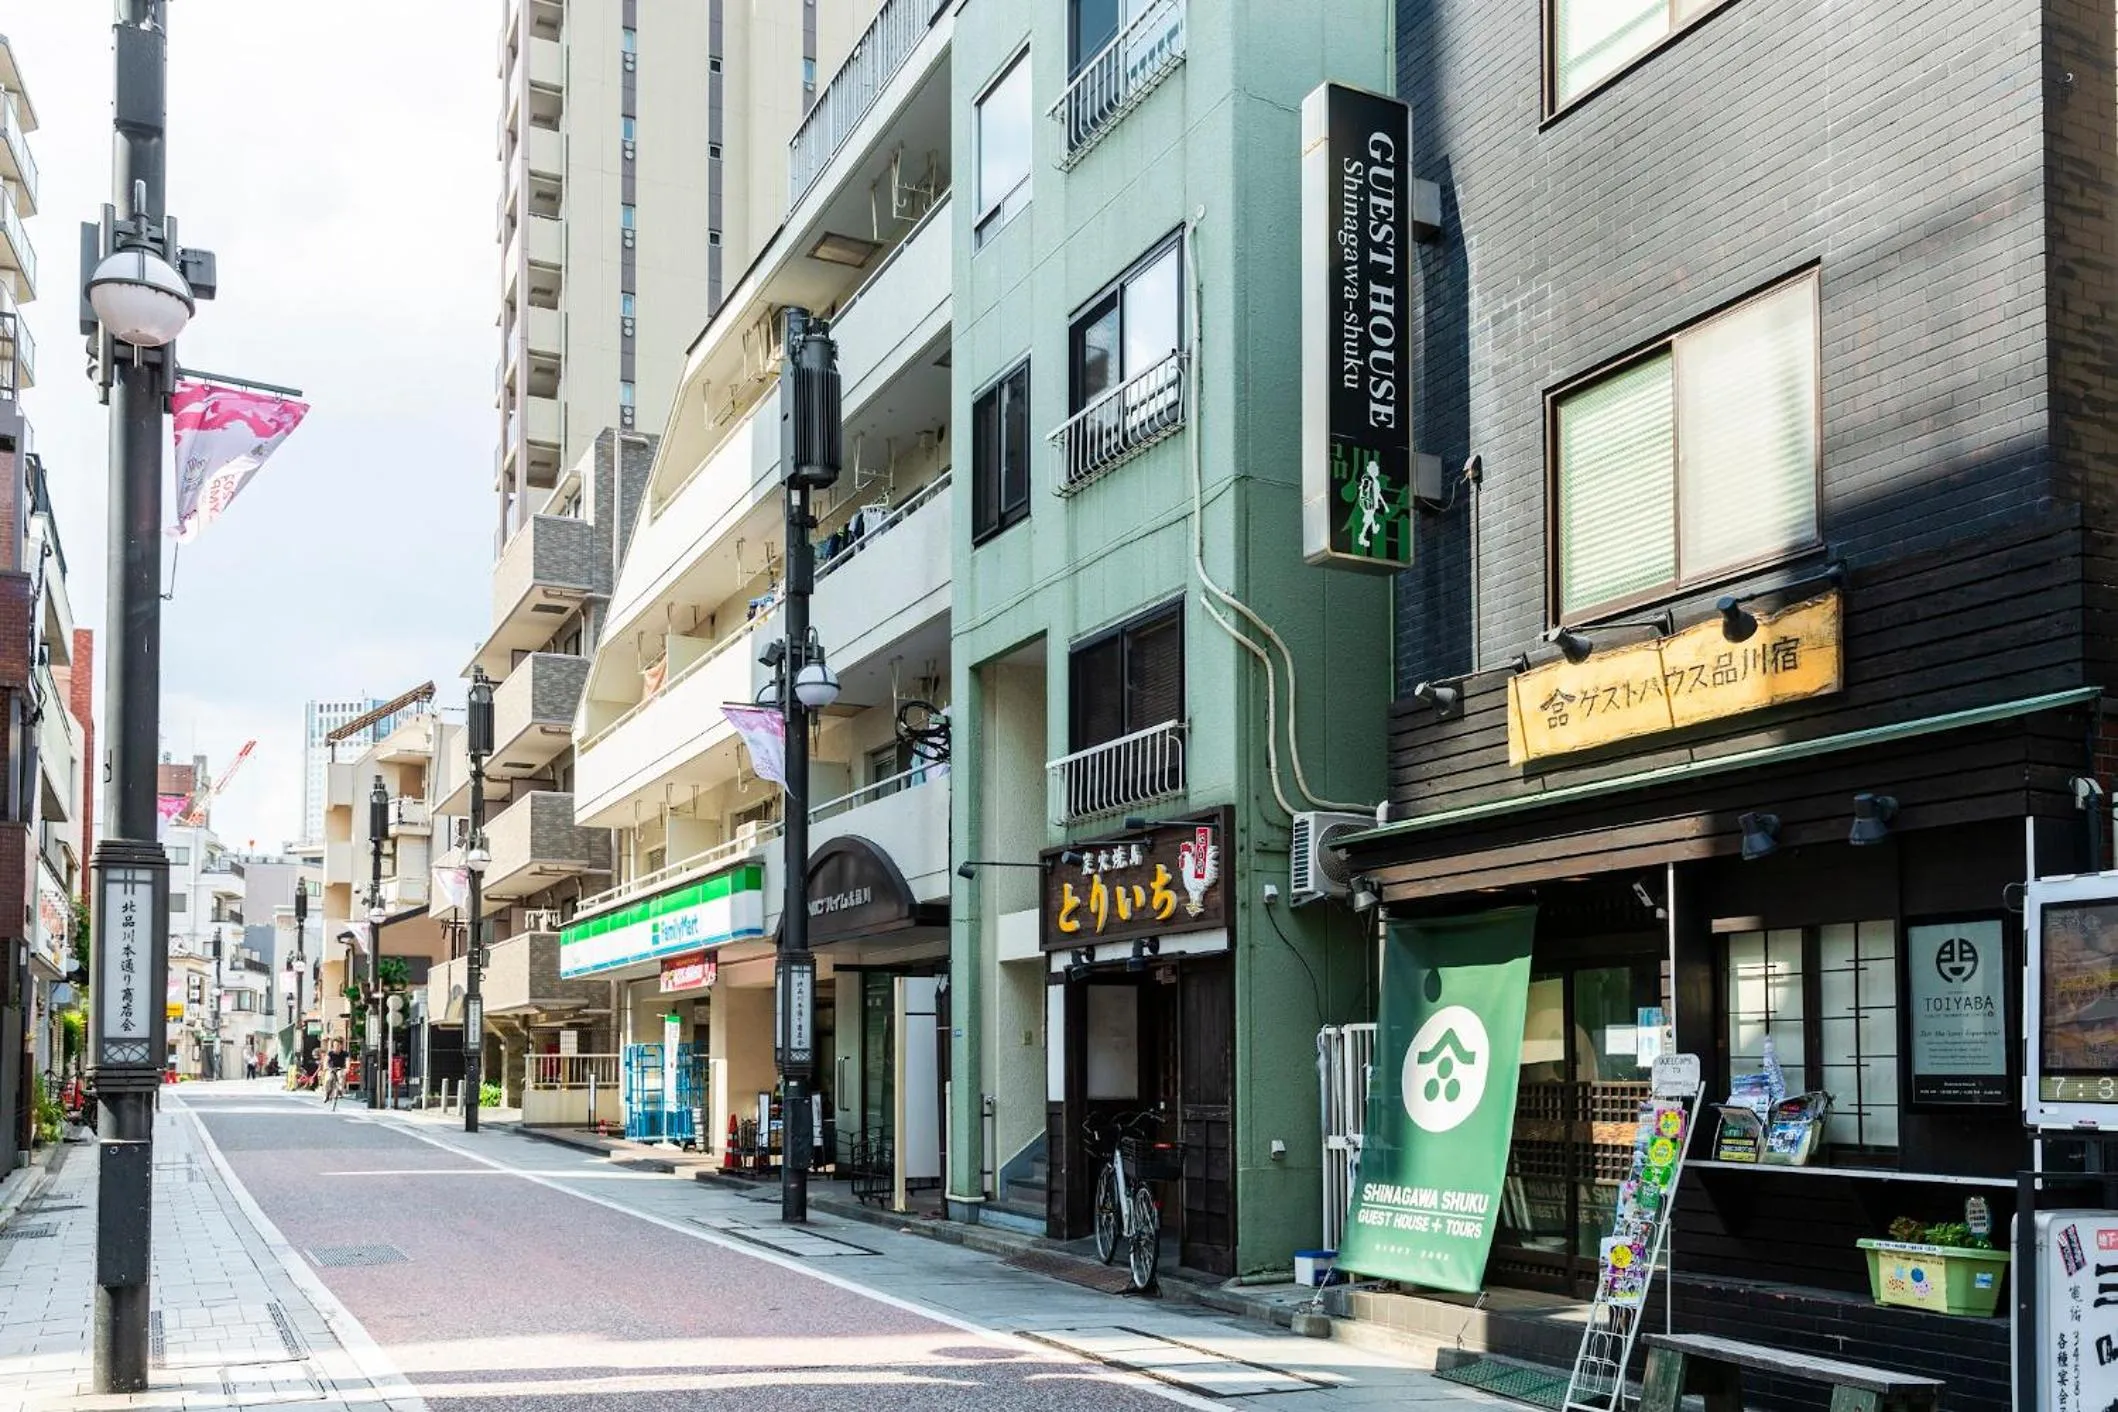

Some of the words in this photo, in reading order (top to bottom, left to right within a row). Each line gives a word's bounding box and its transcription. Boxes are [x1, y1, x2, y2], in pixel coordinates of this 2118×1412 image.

[1368, 131, 1395, 274] GUEST
[1338, 156, 1364, 390] Shinagawa-shuku
[1368, 280, 1396, 428] HOUSE
[660, 914, 699, 942] FamilyMart
[1058, 862, 1178, 934] とりいち
[120, 900, 137, 1032] 北品川本通り商店会
[1923, 995, 1994, 1012] TOIYABA
[1358, 1209, 1393, 1227] GUEST
[1393, 1214, 1430, 1232] HOUSE
[1446, 1219, 1483, 1239] TOURS
[1362, 1183, 1439, 1209] SHINAGAWA
[1441, 1191, 1489, 1214] SHUKU
[2057, 1332, 2069, 1412] 各種宴会
